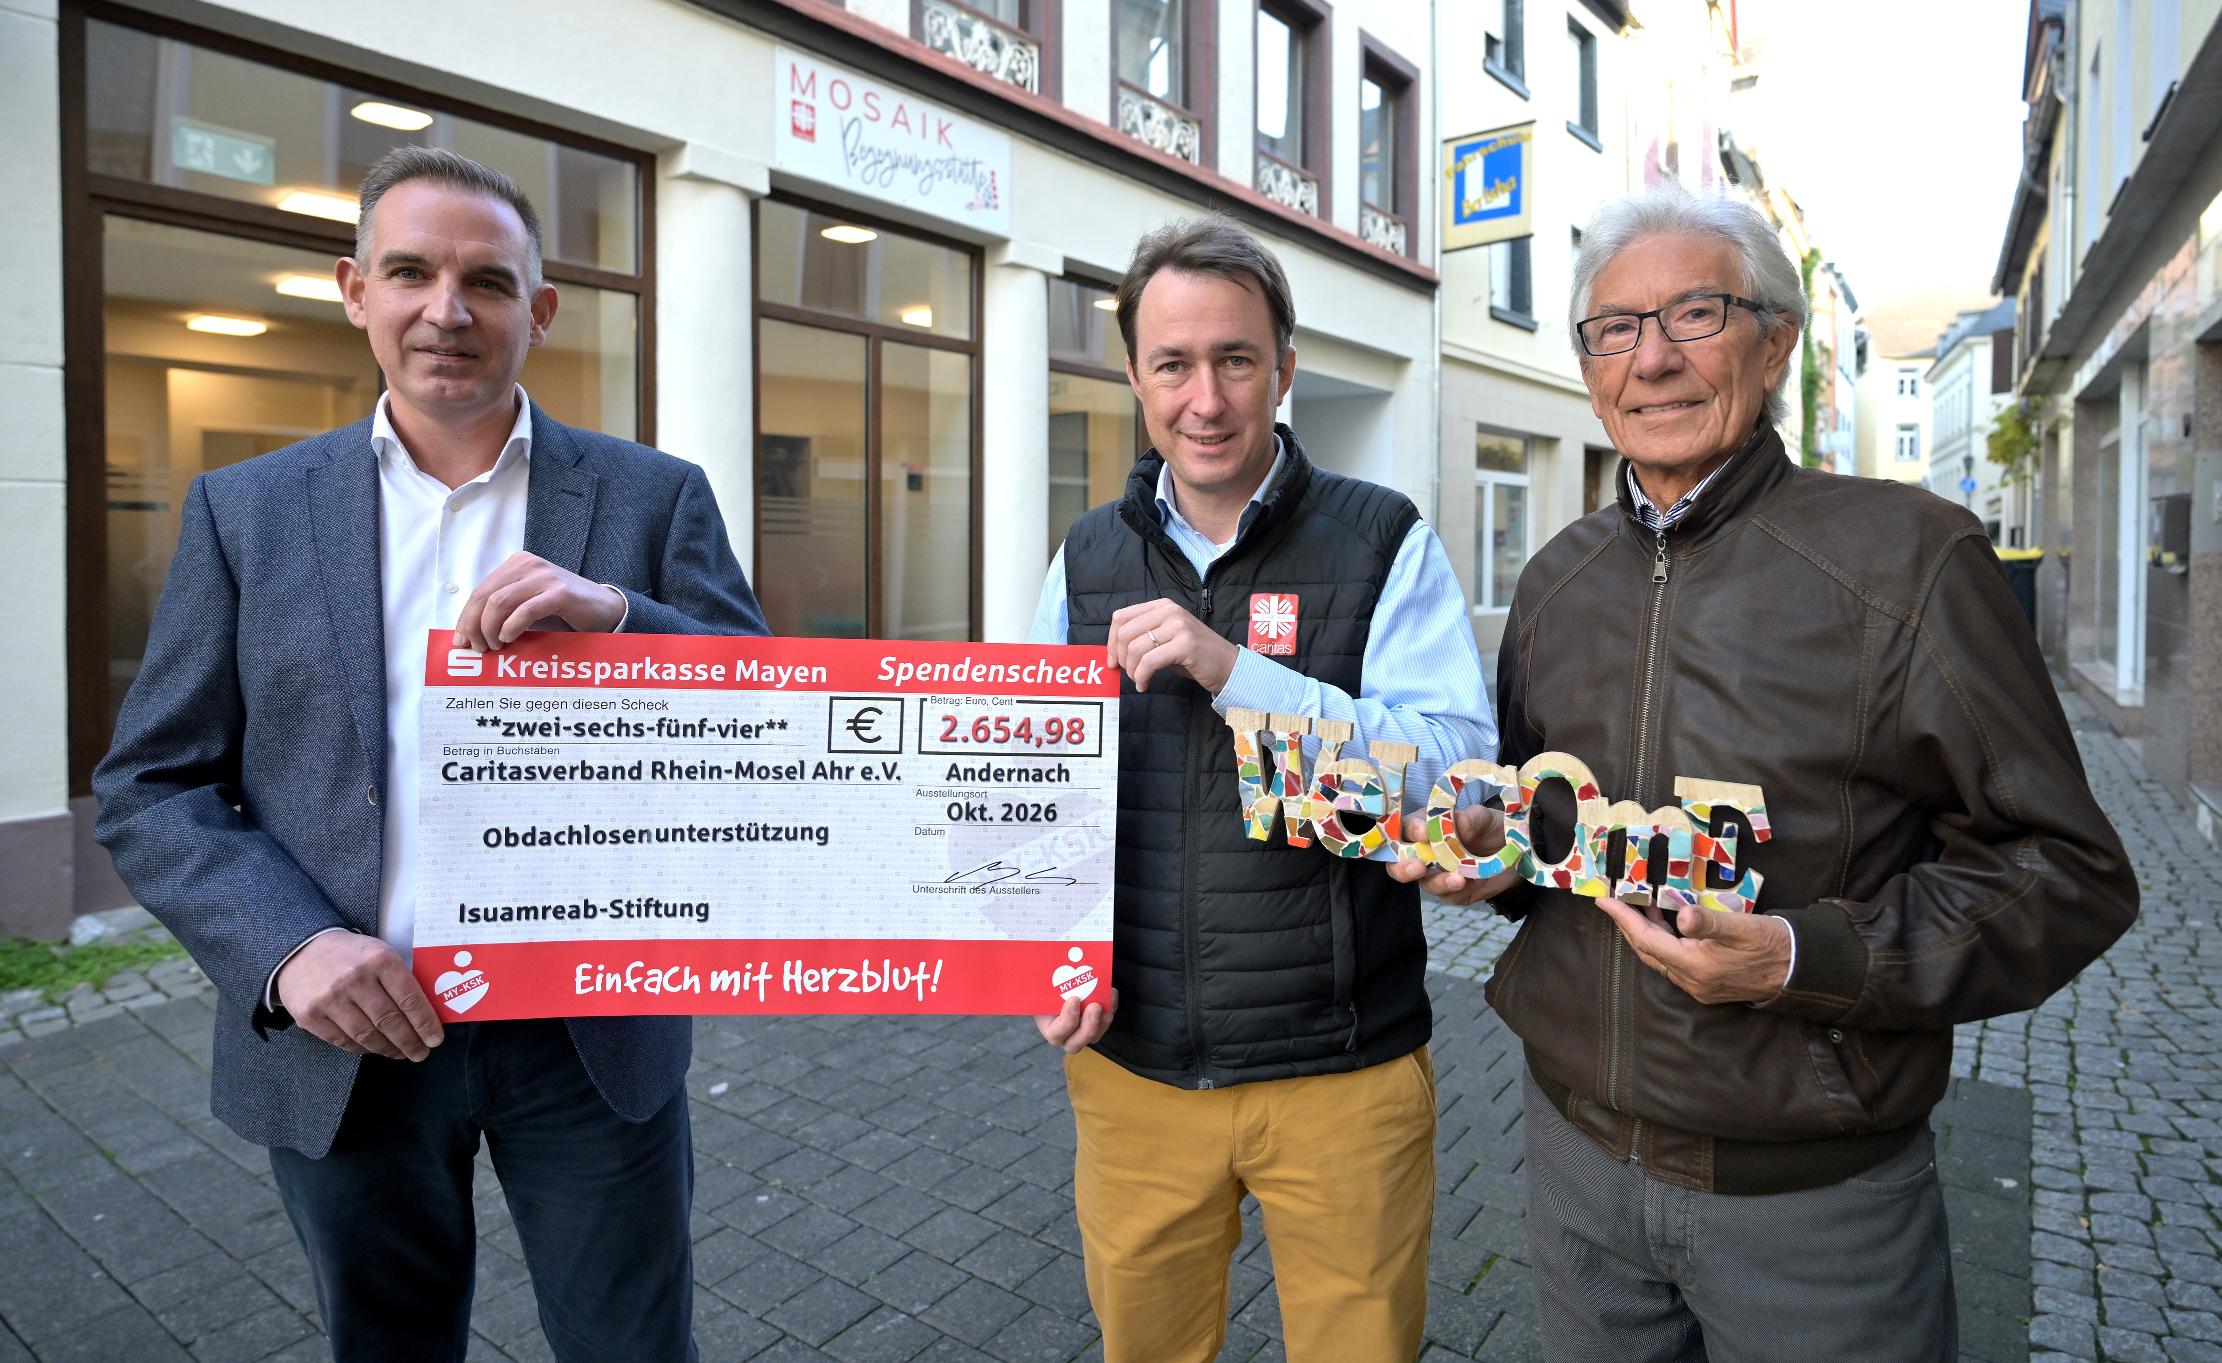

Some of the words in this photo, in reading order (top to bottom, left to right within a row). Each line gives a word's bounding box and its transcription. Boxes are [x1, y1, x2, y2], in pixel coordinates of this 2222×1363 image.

[790, 62, 954, 151] MOSAIK
[497, 654, 726, 685] Kreissparkasse
[735, 660, 828, 688] Mayen
[877, 656, 1105, 687] Spendenscheck
[445, 697, 494, 711] Zahlen
[498, 697, 522, 711] Sie
[525, 699, 568, 713] gegen
[572, 698, 617, 711] diesen
[620, 698, 669, 711] Scheck
[930, 695, 964, 707] Betrag:
[965, 696, 989, 707] Euro,
[991, 696, 1014, 706] Cent
[845, 706, 883, 744] €
[938, 714, 1086, 748] 2.654,98
[443, 745, 480, 757] Betrag
[483, 745, 493, 756] in
[497, 745, 560, 756] Buchstaben
[441, 760, 642, 782] Caritasverband
[651, 760, 806, 782] Rhein-Mosel
[811, 760, 855, 782] Ahr
[860, 761, 902, 782] e.V.
[945, 763, 1071, 783] Andernach
[915, 788, 988, 800] Ausstellungsort
[946, 802, 994, 823] Okt.
[1000, 802, 1058, 823] 2026
[482, 824, 829, 848] Obdachlosenunterstützung
[914, 826, 946, 837] Datum
[912, 884, 968, 895] Unterschrift
[969, 884, 988, 895] des
[988, 884, 1040, 896] Ausstellers
[458, 897, 710, 924] Isuamreab-Stiftung
[443, 975, 486, 1001] MY-KSK
[575, 960, 700, 995] Einfach
[710, 961, 773, 1003] mit
[782, 959, 943, 1002] Herzblut!
[1059, 971, 1094, 993] MY-KSK
